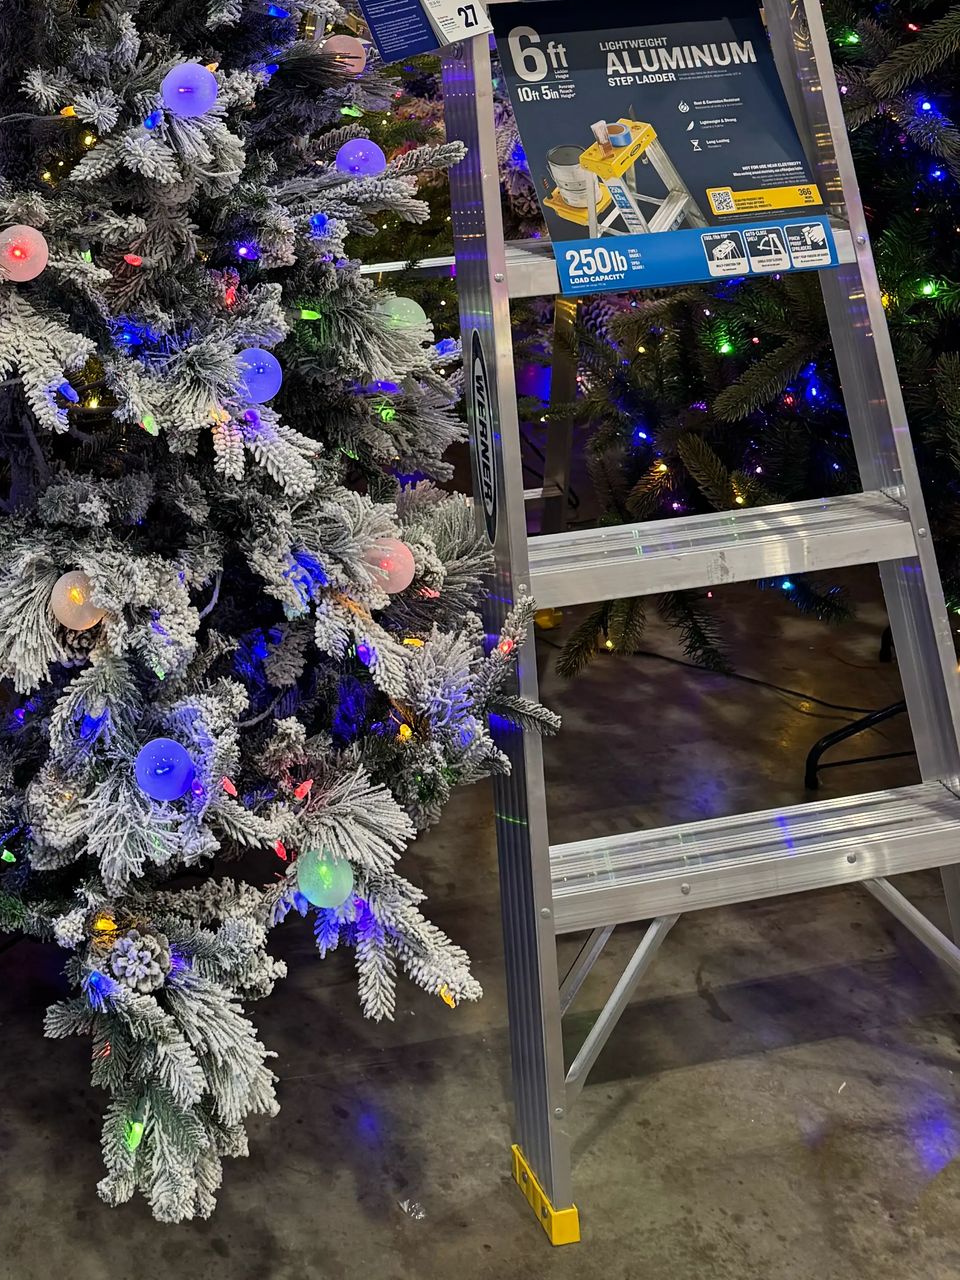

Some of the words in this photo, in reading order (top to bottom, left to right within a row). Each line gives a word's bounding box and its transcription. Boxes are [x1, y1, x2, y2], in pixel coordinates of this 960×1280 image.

[457, 4, 479, 28] 27
[599, 37, 668, 51] LIGHTWEIGHT
[606, 40, 758, 76] ALUMINUM
[608, 76, 634, 88] STEP
[636, 72, 677, 85] LADDER
[797, 187, 812, 196] 366
[569, 277, 589, 285] LOAD
[590, 273, 625, 283] CAPACITY
[475, 375, 493, 503] WERNER
